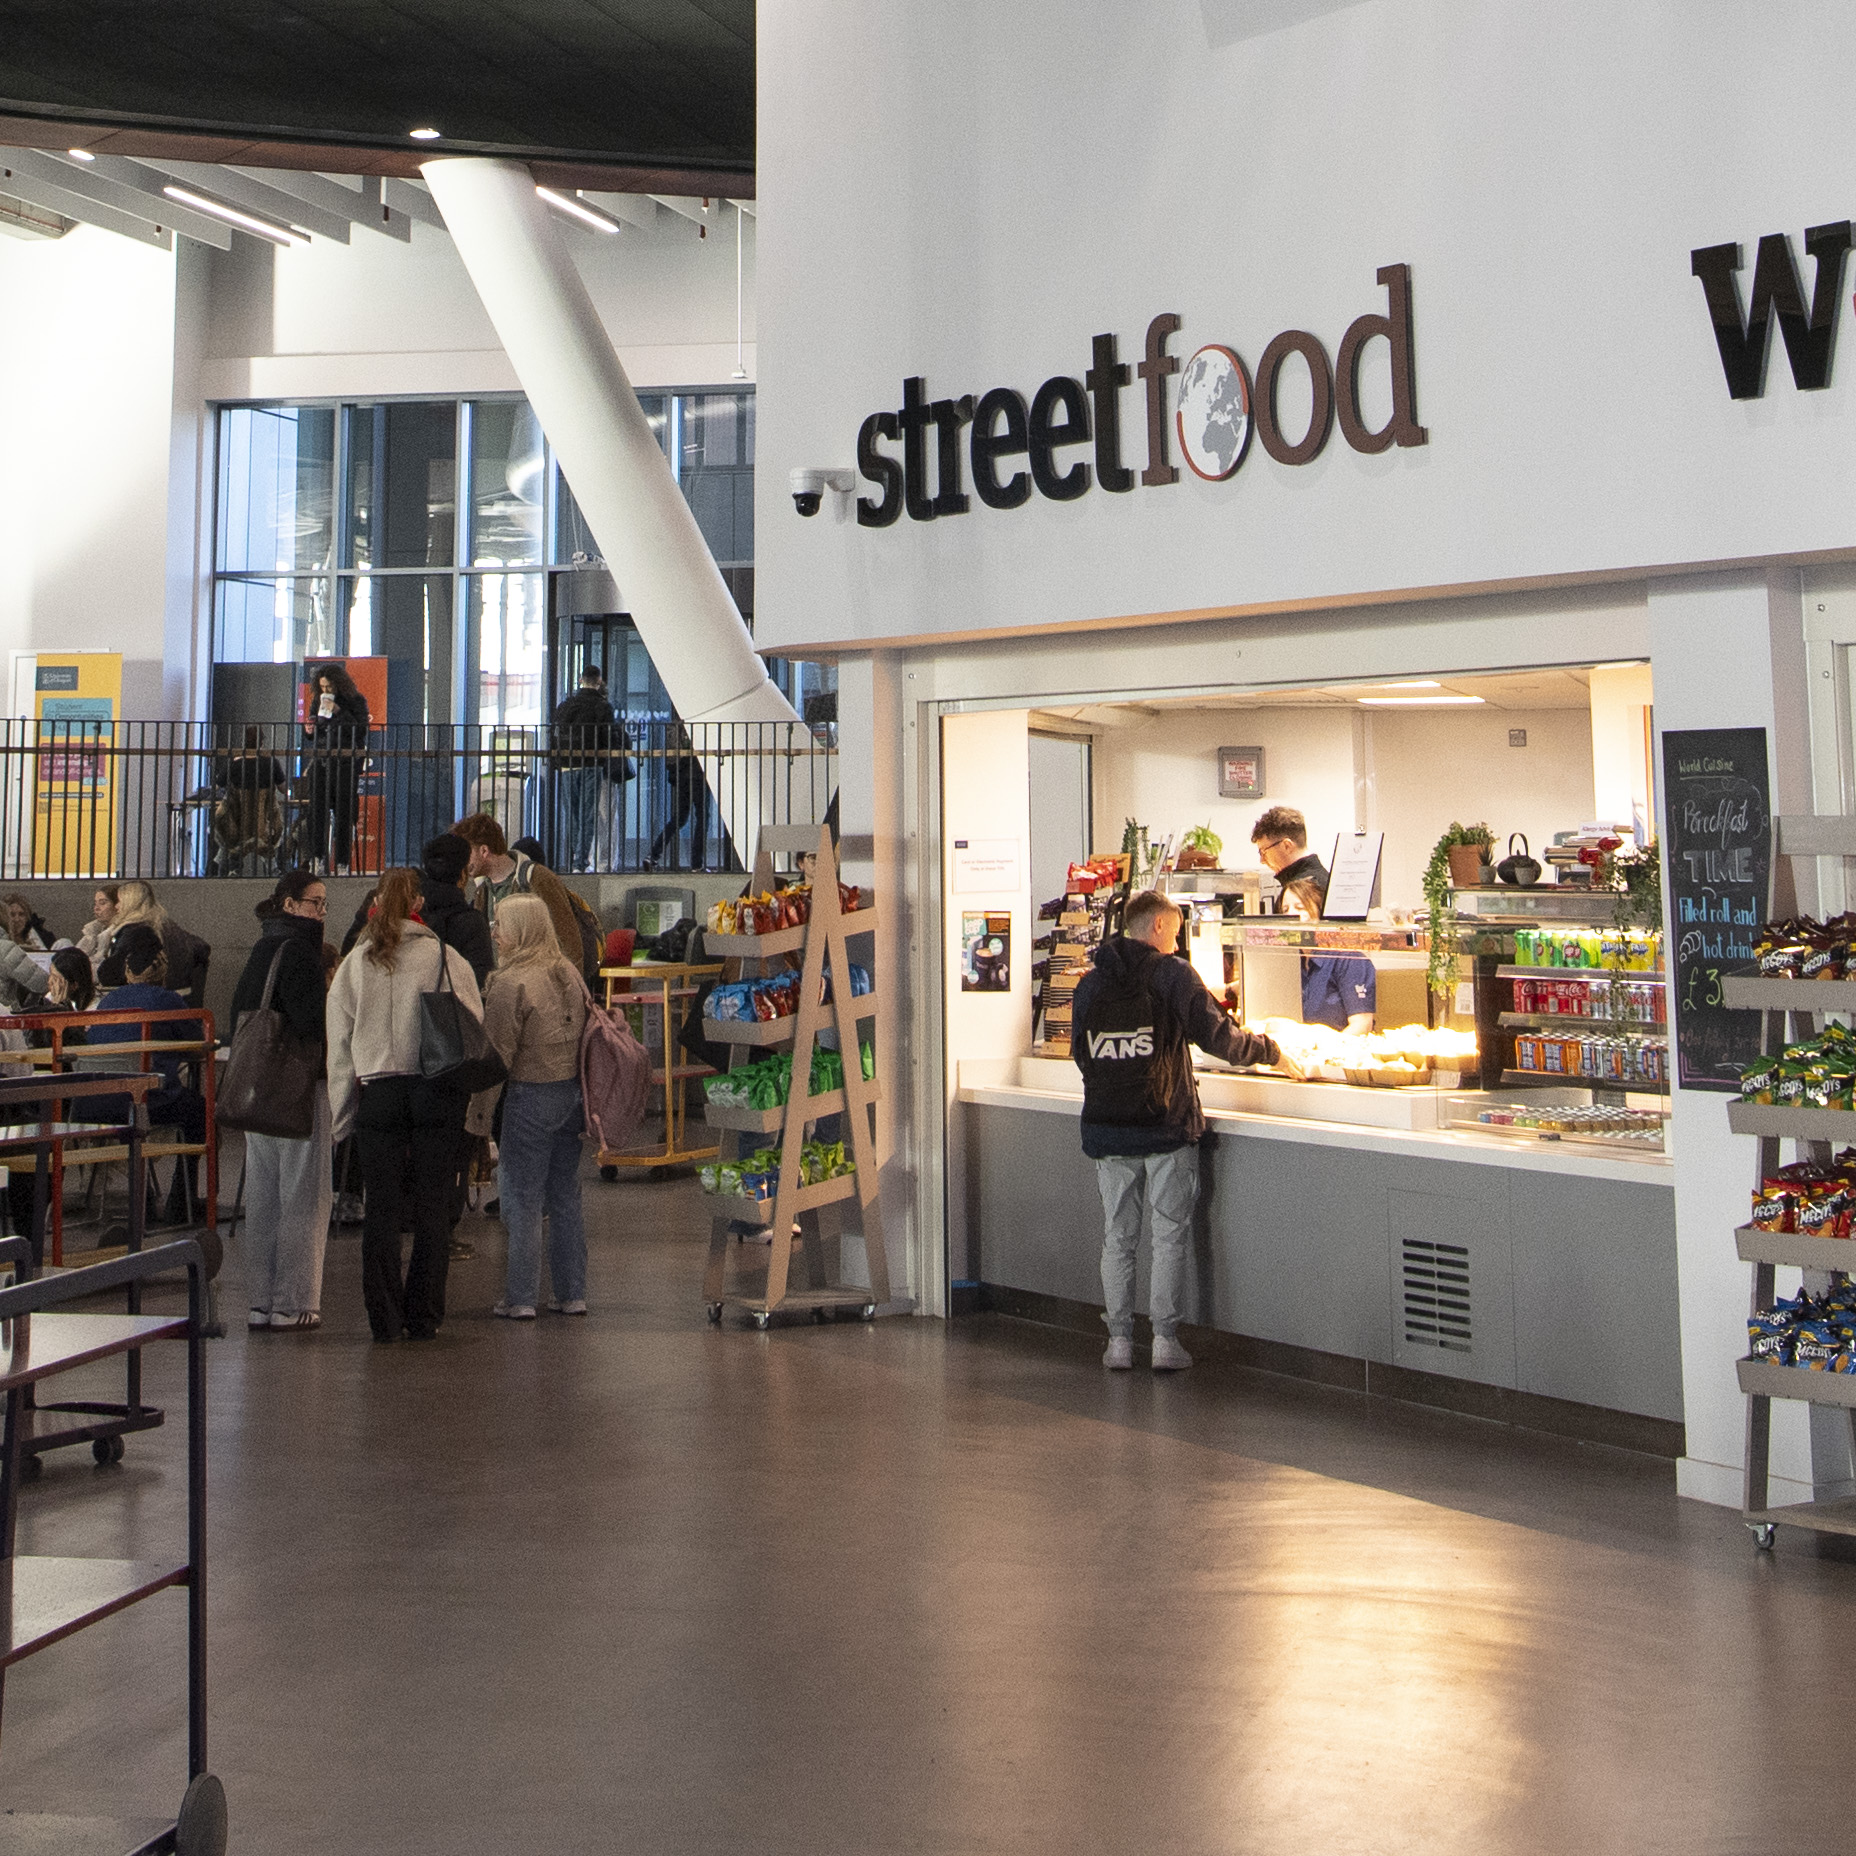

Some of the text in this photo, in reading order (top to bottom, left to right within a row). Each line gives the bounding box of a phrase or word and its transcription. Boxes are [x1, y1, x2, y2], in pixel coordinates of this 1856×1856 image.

[1679, 757, 1734, 773] World Cuisine
[1683, 847, 1754, 882] TIME
[1679, 896, 1757, 926] Filled roll and
[1702, 931, 1724, 959] hot
[1086, 1026, 1154, 1060] VANS
